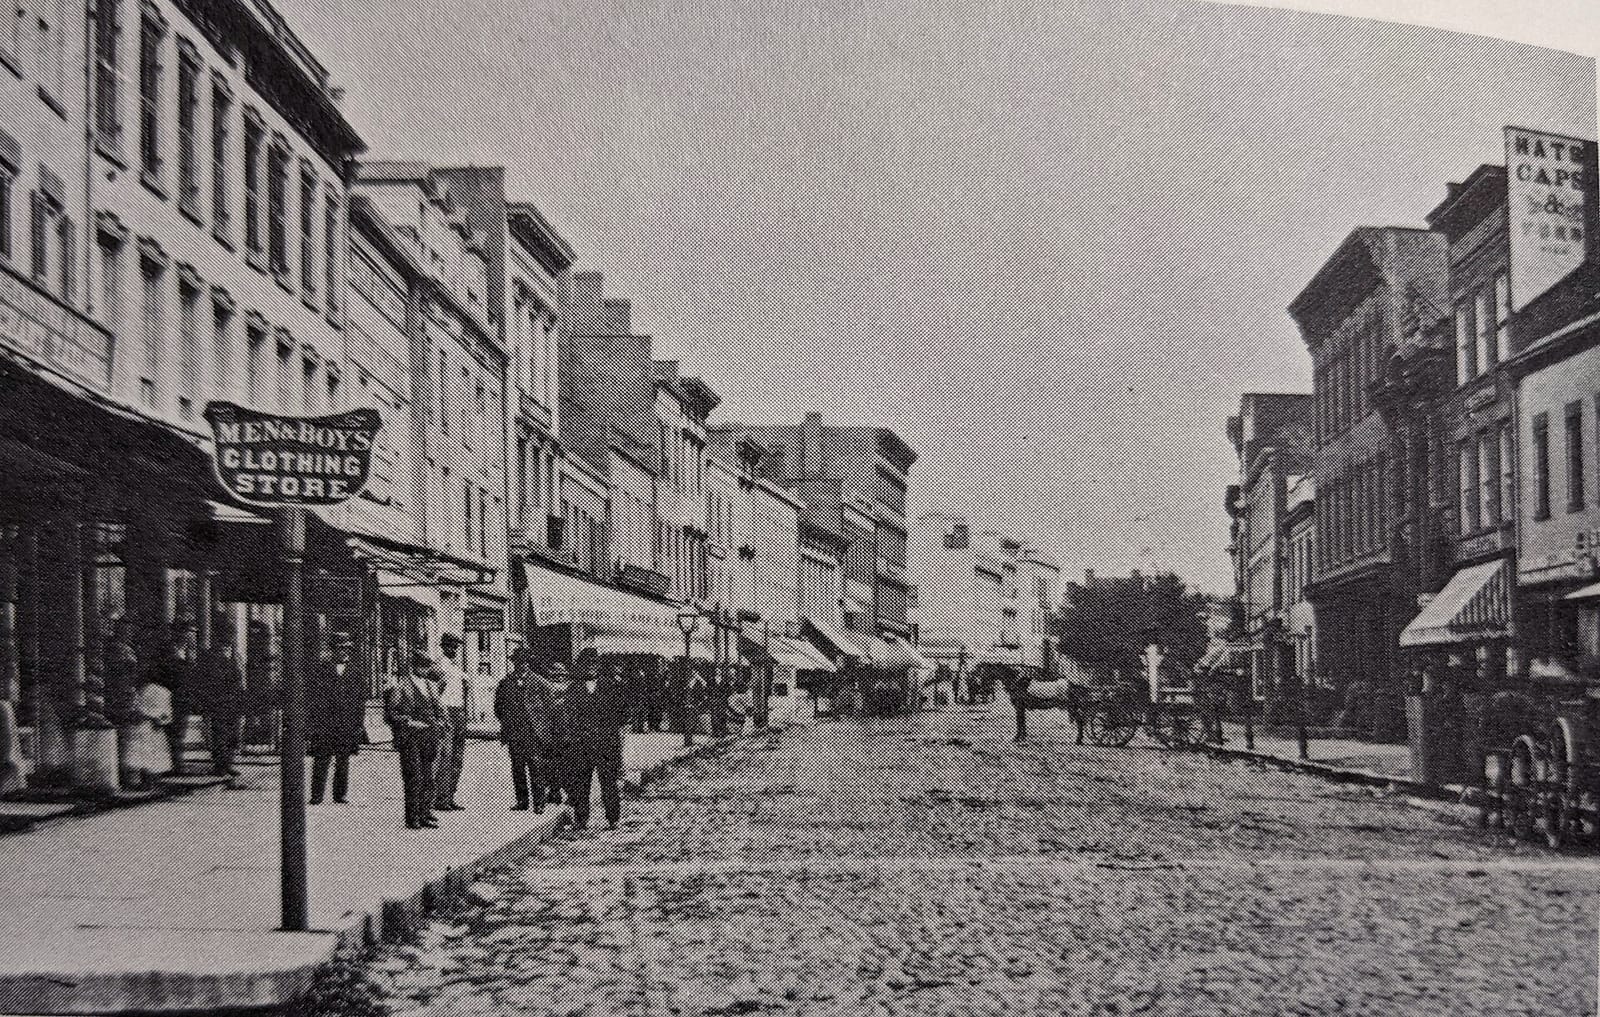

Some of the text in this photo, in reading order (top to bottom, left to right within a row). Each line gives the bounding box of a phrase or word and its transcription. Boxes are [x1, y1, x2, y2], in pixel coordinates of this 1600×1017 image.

[1516, 162, 1584, 191] CAPS
[223, 448, 362, 477] CLOTHING
[235, 473, 349, 499] STORE
